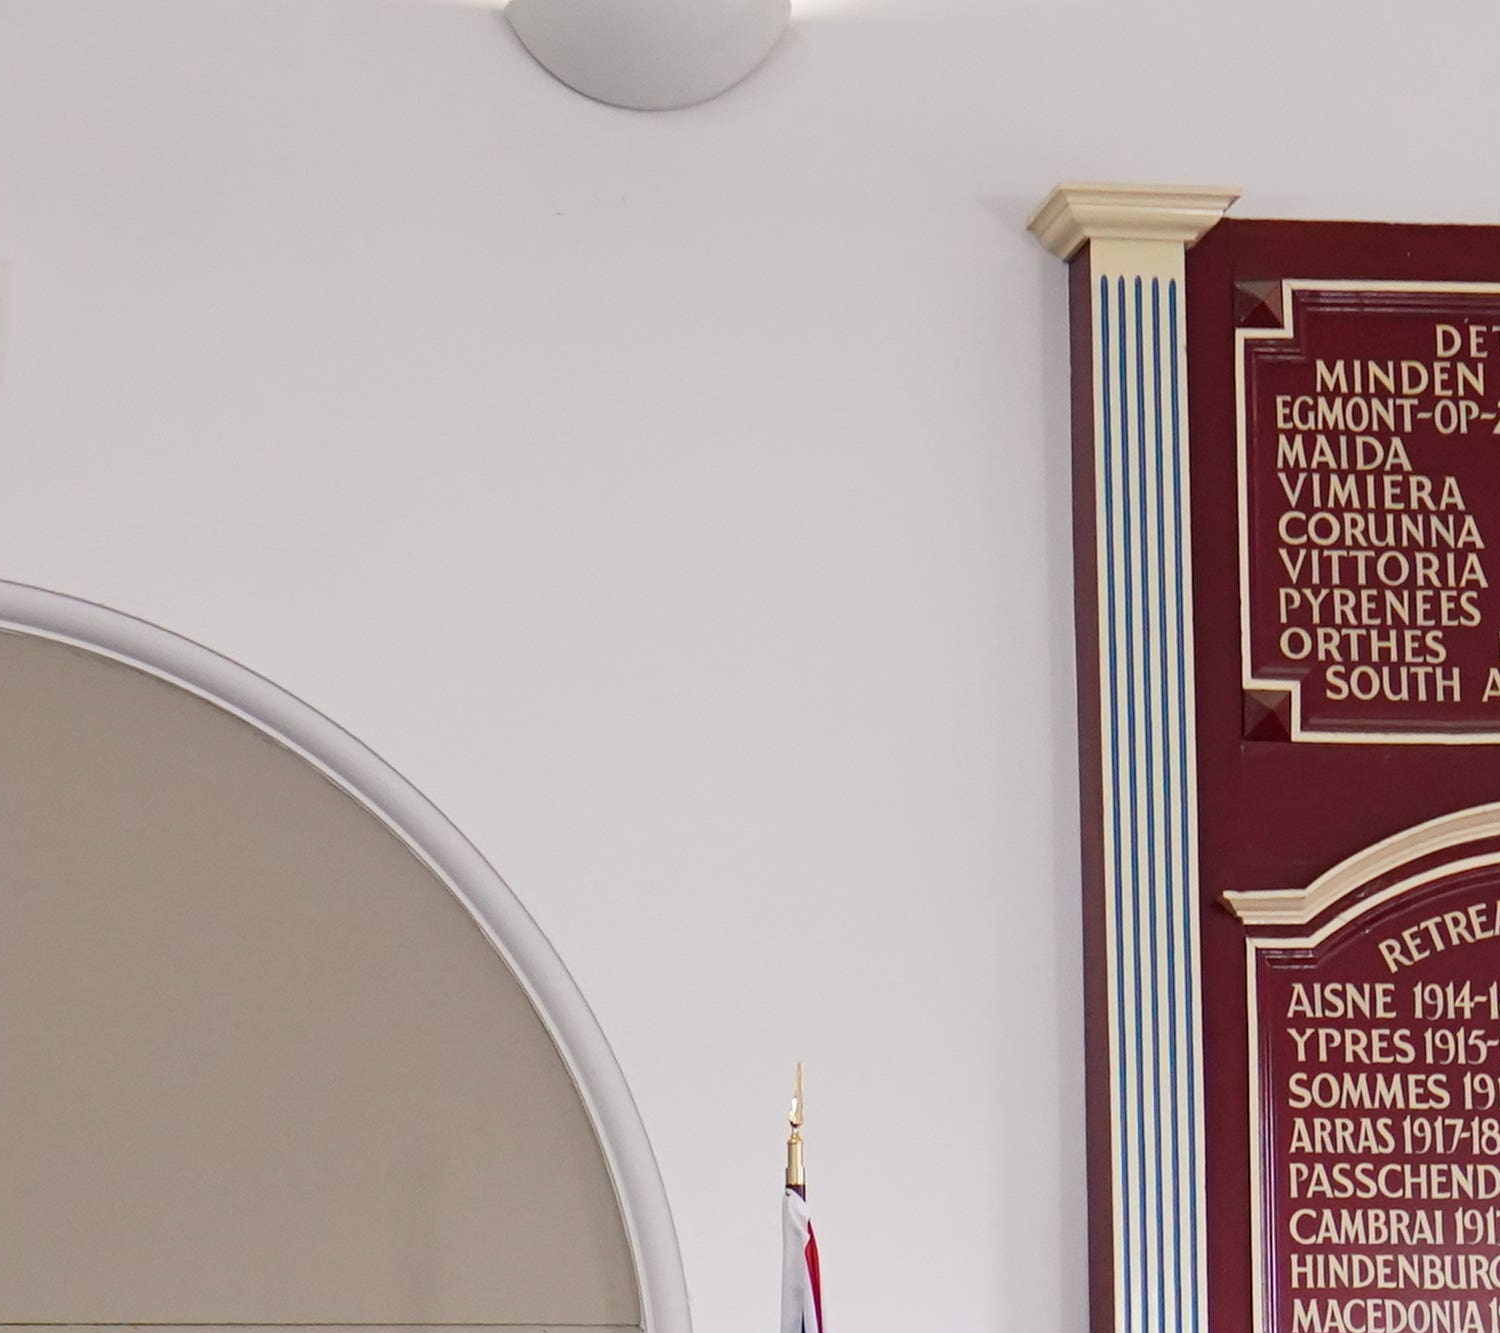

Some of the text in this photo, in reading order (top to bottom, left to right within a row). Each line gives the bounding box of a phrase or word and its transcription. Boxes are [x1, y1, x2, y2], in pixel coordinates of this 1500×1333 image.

[1316, 360, 1483, 396] MINDEN
[1278, 434, 1412, 471] MAIDA
[1278, 473, 1465, 510] VIMIERA
[1279, 511, 1484, 548] CORUNNA
[1279, 549, 1488, 587] VITTORIA
[1280, 588, 1481, 626] PYRENEES
[1280, 627, 1446, 663] ORTHES
[1326, 665, 1460, 701] SOUTH
[1288, 983, 1396, 1018] AISNE
[1288, 1029, 1415, 1063] YPRES
[1289, 1073, 1450, 1109] SOMMES
[1290, 1118, 1395, 1153] ARRAS
[1290, 1209, 1443, 1245] CAMBRAI
